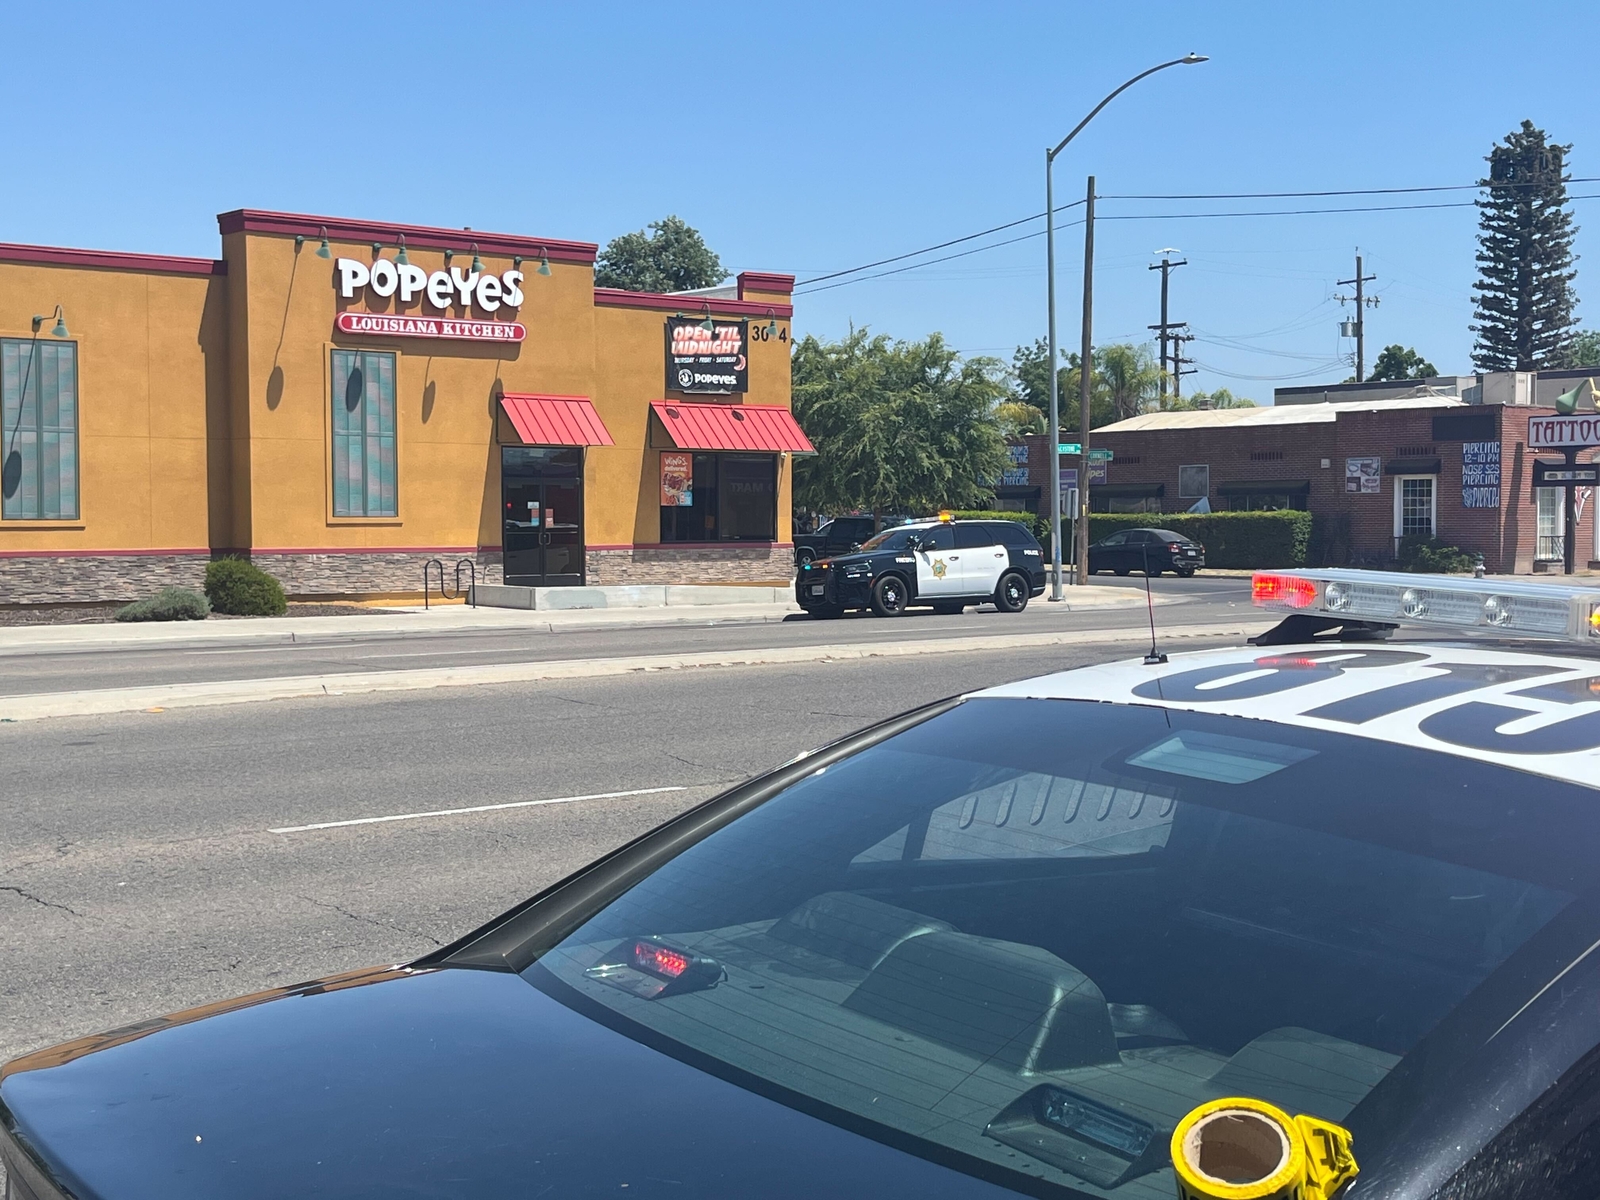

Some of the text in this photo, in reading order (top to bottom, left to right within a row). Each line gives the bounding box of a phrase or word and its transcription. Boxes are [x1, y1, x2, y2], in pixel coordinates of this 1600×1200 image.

[351, 316, 515, 338] LOUISIANA KITCHEN
[673, 326, 712, 341] OPEN
[751, 325, 787, 343] 304
[671, 340, 742, 355] MIDNIGHT
[1462, 441, 1500, 454] PIERCING
[1487, 453, 1499, 462] PM
[1462, 474, 1499, 485] PIERCING
